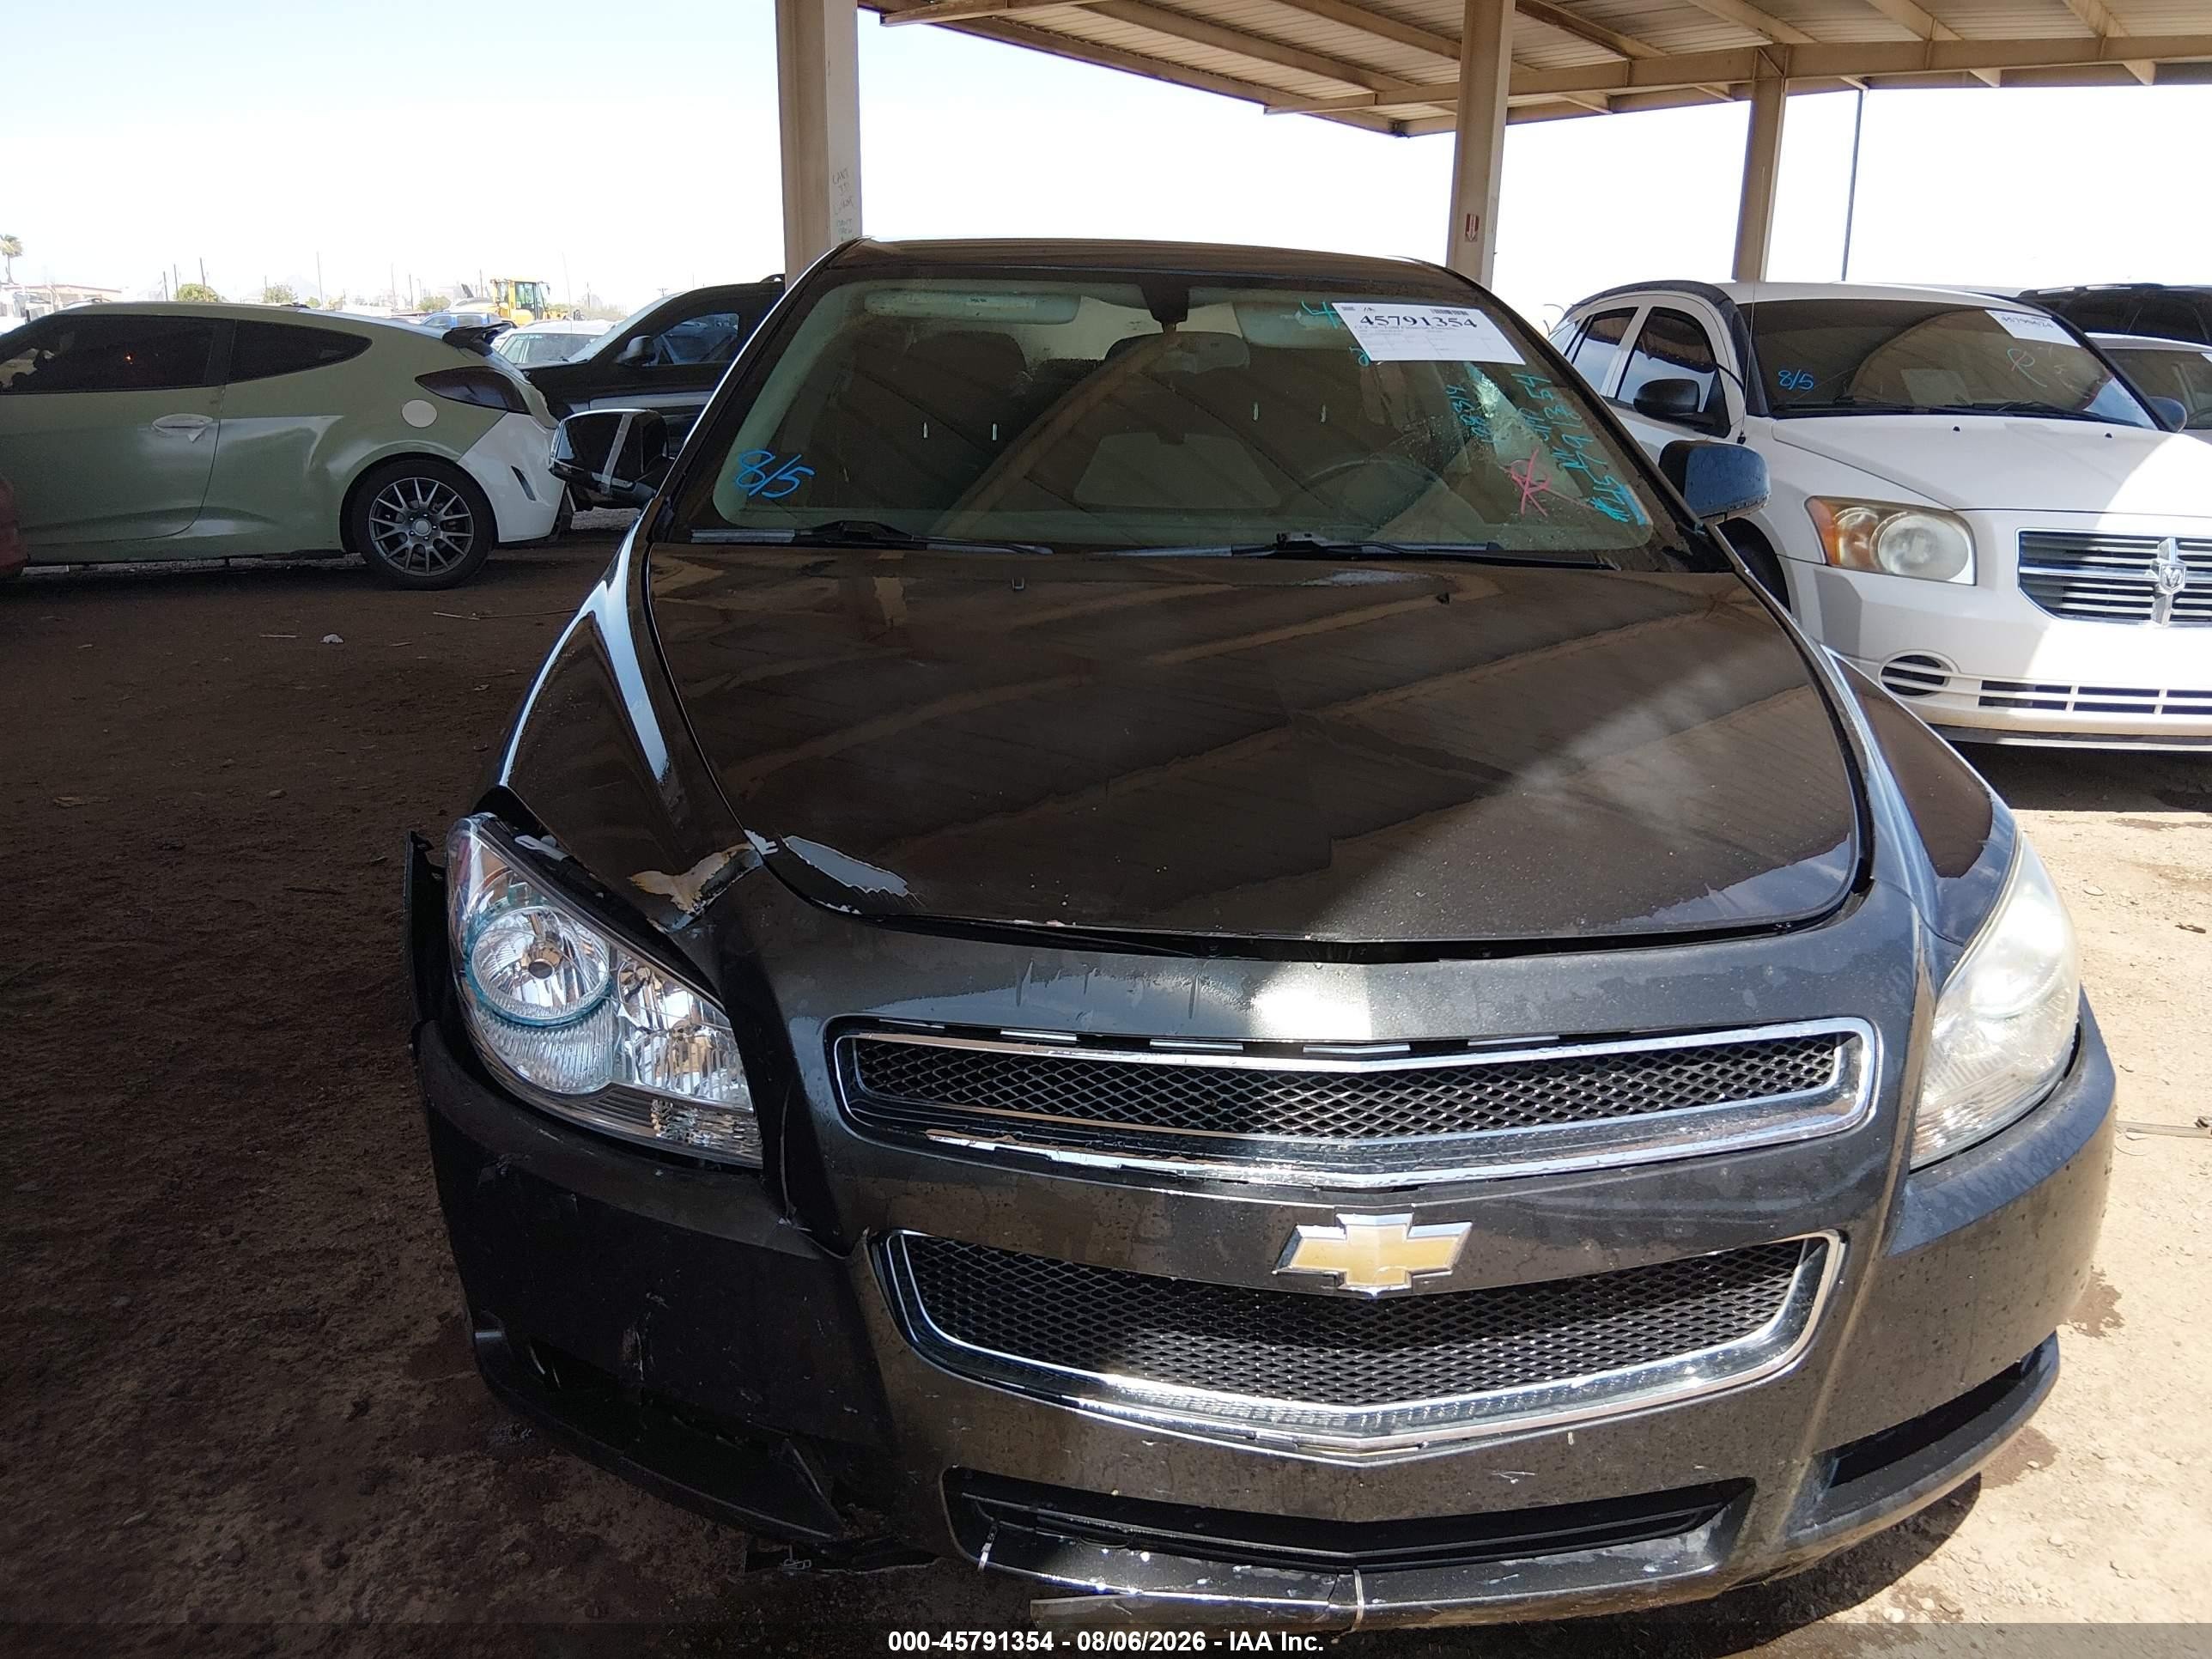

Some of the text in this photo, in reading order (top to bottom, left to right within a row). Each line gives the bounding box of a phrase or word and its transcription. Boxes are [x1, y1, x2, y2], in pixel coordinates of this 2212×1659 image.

[1360, 315, 1478, 328] 45791354
[1778, 369, 1814, 391] 8/5
[736, 449, 816, 498] 8/5
